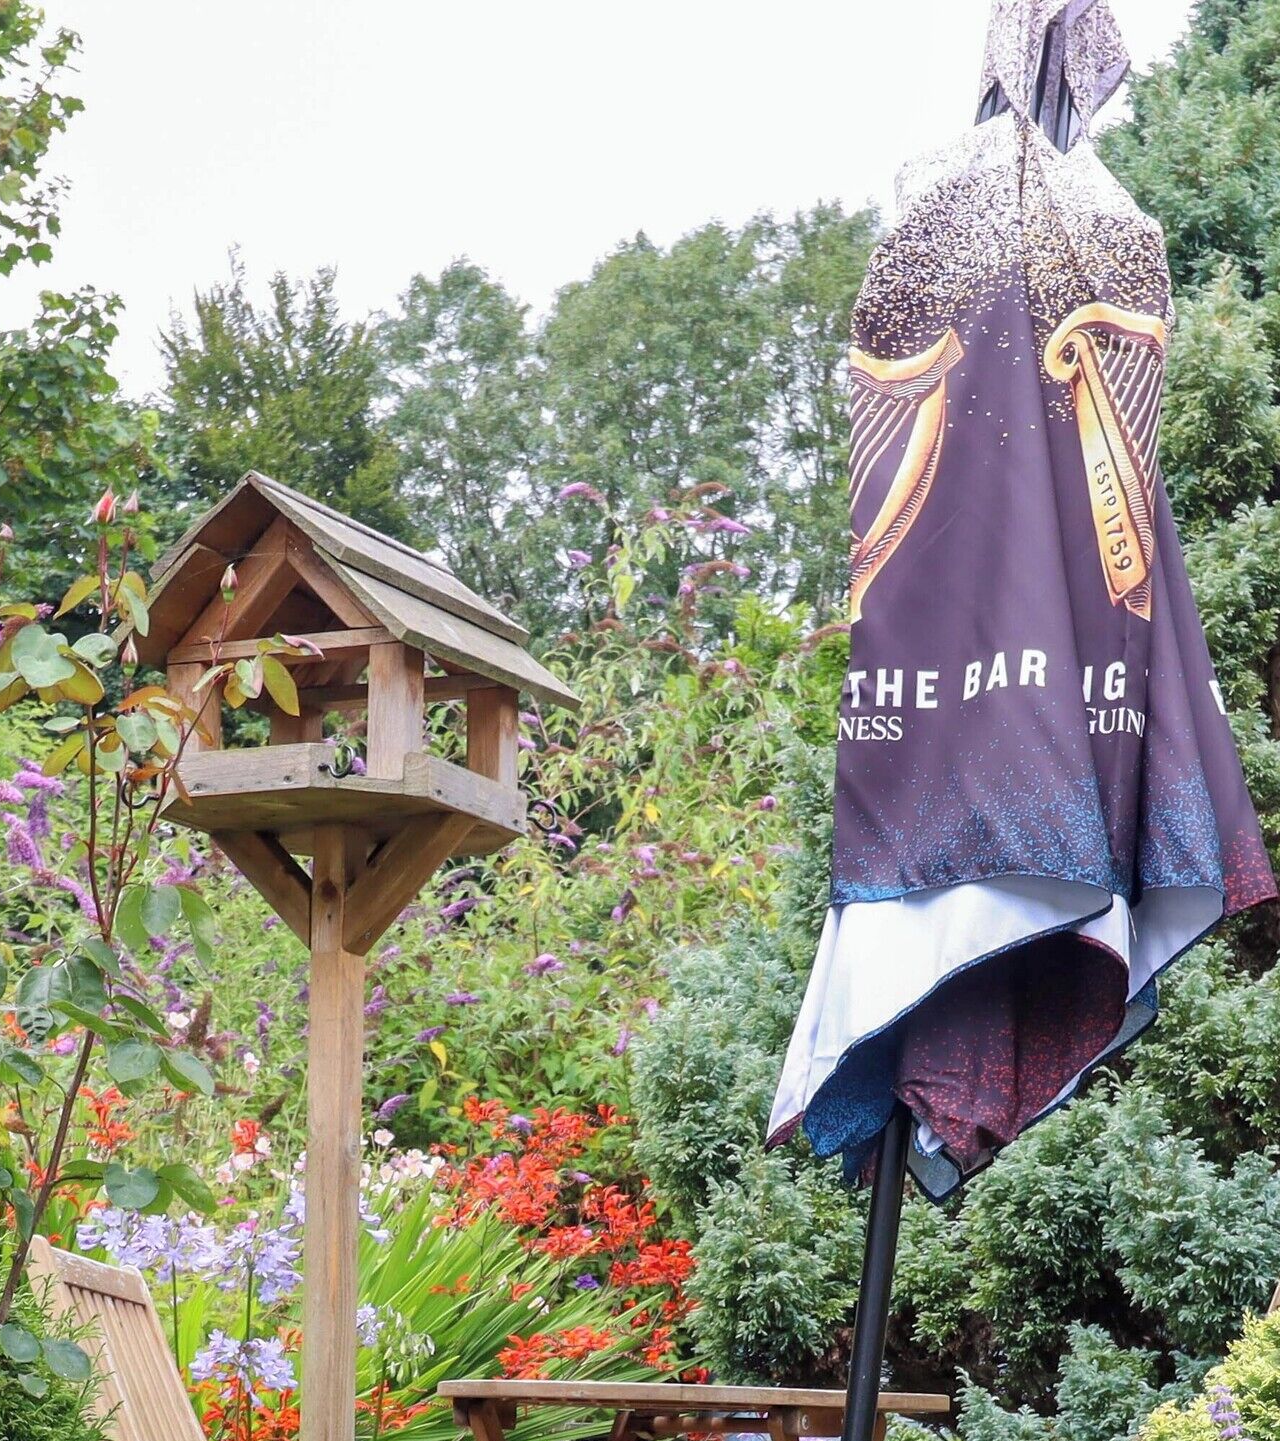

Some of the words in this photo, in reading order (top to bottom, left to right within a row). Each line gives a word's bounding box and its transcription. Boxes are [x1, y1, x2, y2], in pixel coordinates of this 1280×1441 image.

[1104, 512, 1132, 571] 1759
[847, 668, 940, 709] THE
[963, 649, 1048, 701] BAR
[837, 715, 904, 741] NESS
